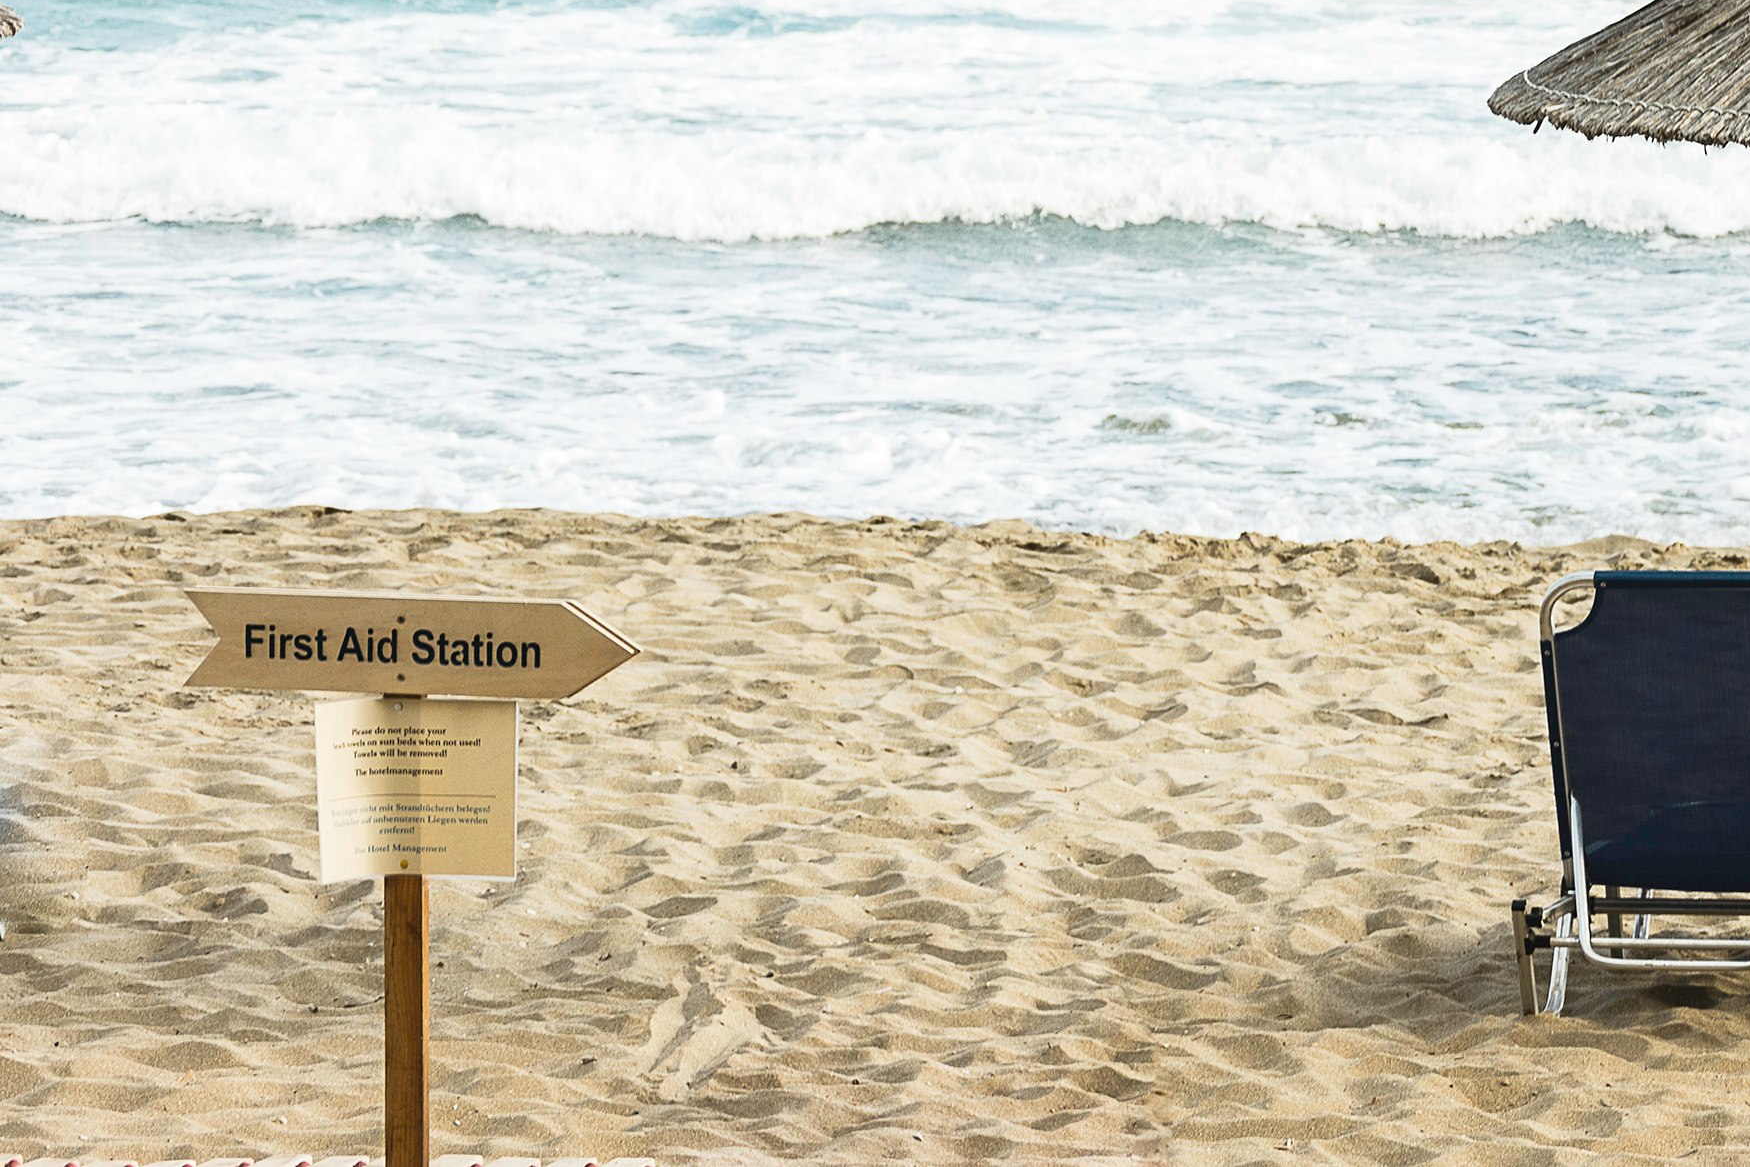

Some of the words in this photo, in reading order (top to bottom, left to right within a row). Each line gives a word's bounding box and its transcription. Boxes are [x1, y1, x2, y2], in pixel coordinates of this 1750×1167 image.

[245, 623, 327, 662] First
[337, 626, 398, 664] Aid
[411, 628, 541, 668] Station
[374, 726, 386, 734] do
[388, 727, 402, 735] not
[404, 726, 425, 737] place
[427, 728, 447, 737] your
[379, 738, 395, 746] sun
[397, 737, 416, 746] beds
[418, 737, 441, 746] when
[459, 738, 481, 747] used!
[379, 748, 395, 757] will
[397, 748, 408, 757] be
[409, 749, 447, 758] removed!
[369, 766, 443, 777] hotelmanagement
[379, 803, 394, 812] mit
[456, 804, 491, 815] belegen!
[427, 815, 456, 825] Liegen
[458, 816, 488, 824] werden
[367, 844, 390, 853] Hotel
[392, 843, 447, 854] Management
